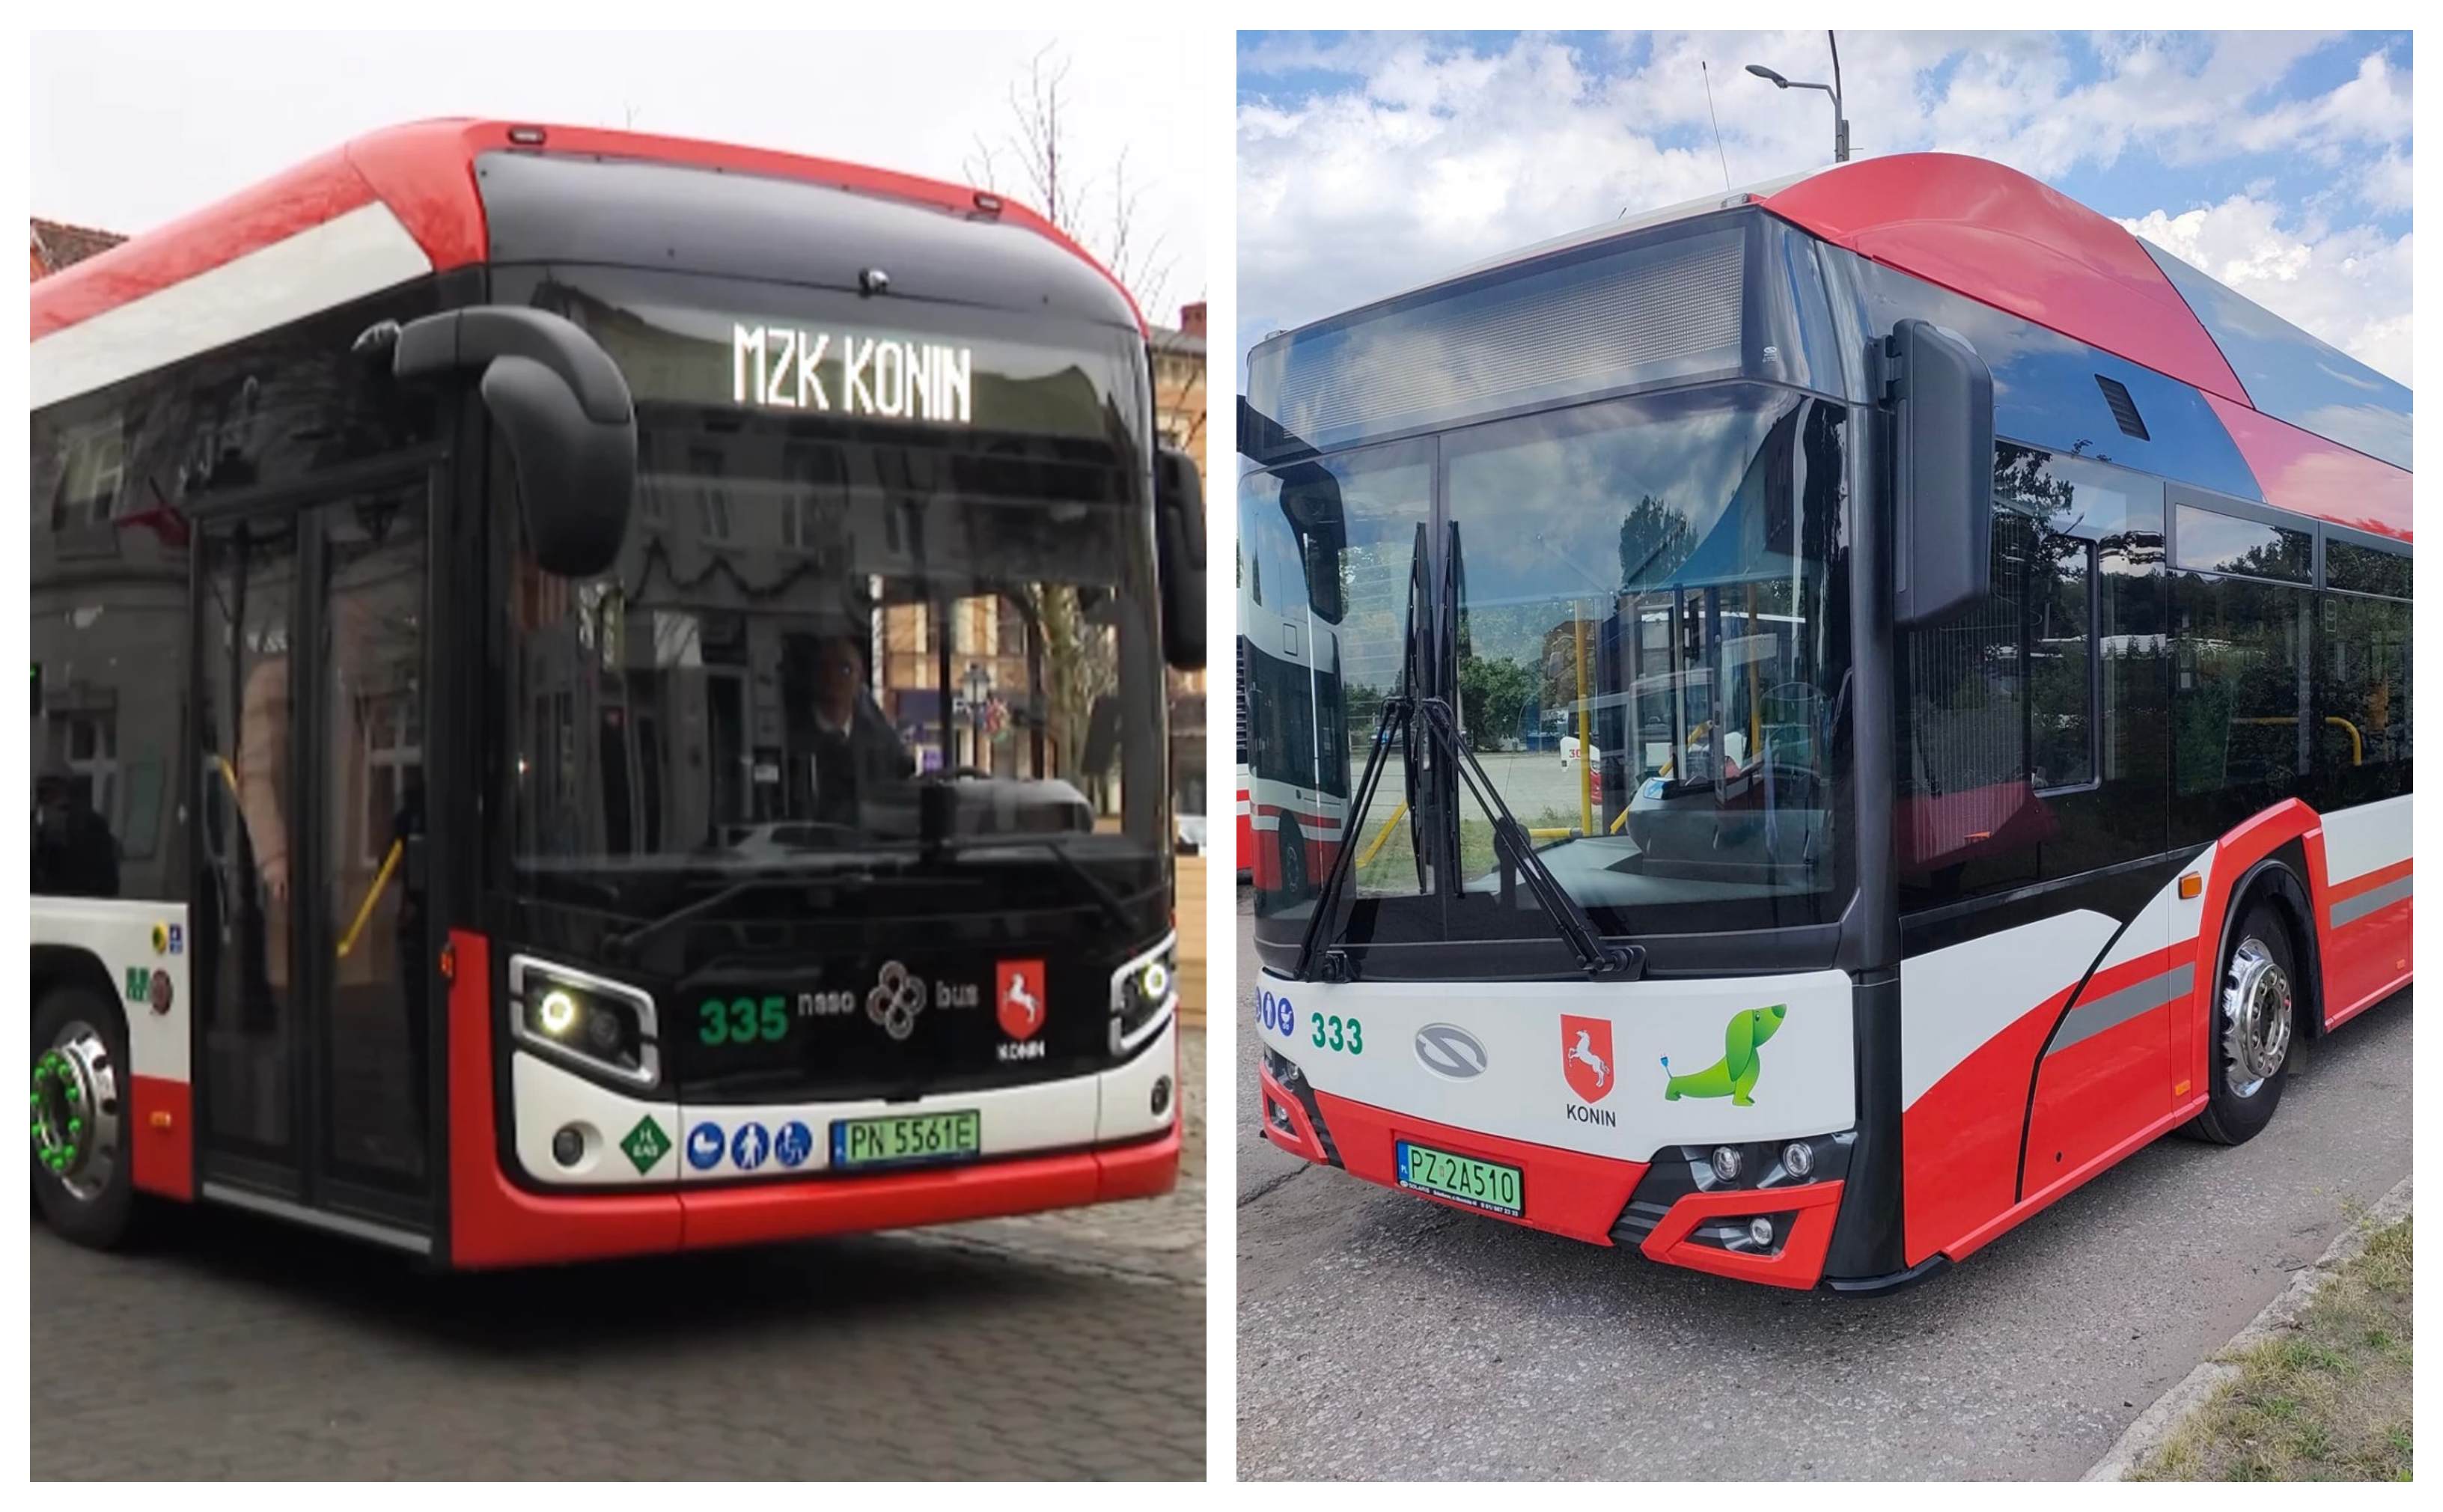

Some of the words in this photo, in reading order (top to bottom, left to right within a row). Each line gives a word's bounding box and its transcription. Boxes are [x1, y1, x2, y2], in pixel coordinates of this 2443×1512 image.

[733, 323, 829, 412] MZK
[844, 335, 972, 422] KONIN
[699, 996, 788, 1046] 335
[1311, 1012, 1363, 1055] 333
[1566, 1104, 1616, 1127] KONIN
[851, 1121, 884, 1159] PN
[897, 1118, 972, 1153] 5561E
[1401, 1165, 1408, 1174] PL
[1411, 1149, 1438, 1184] PZ
[1445, 1158, 1513, 1203] 2A510
